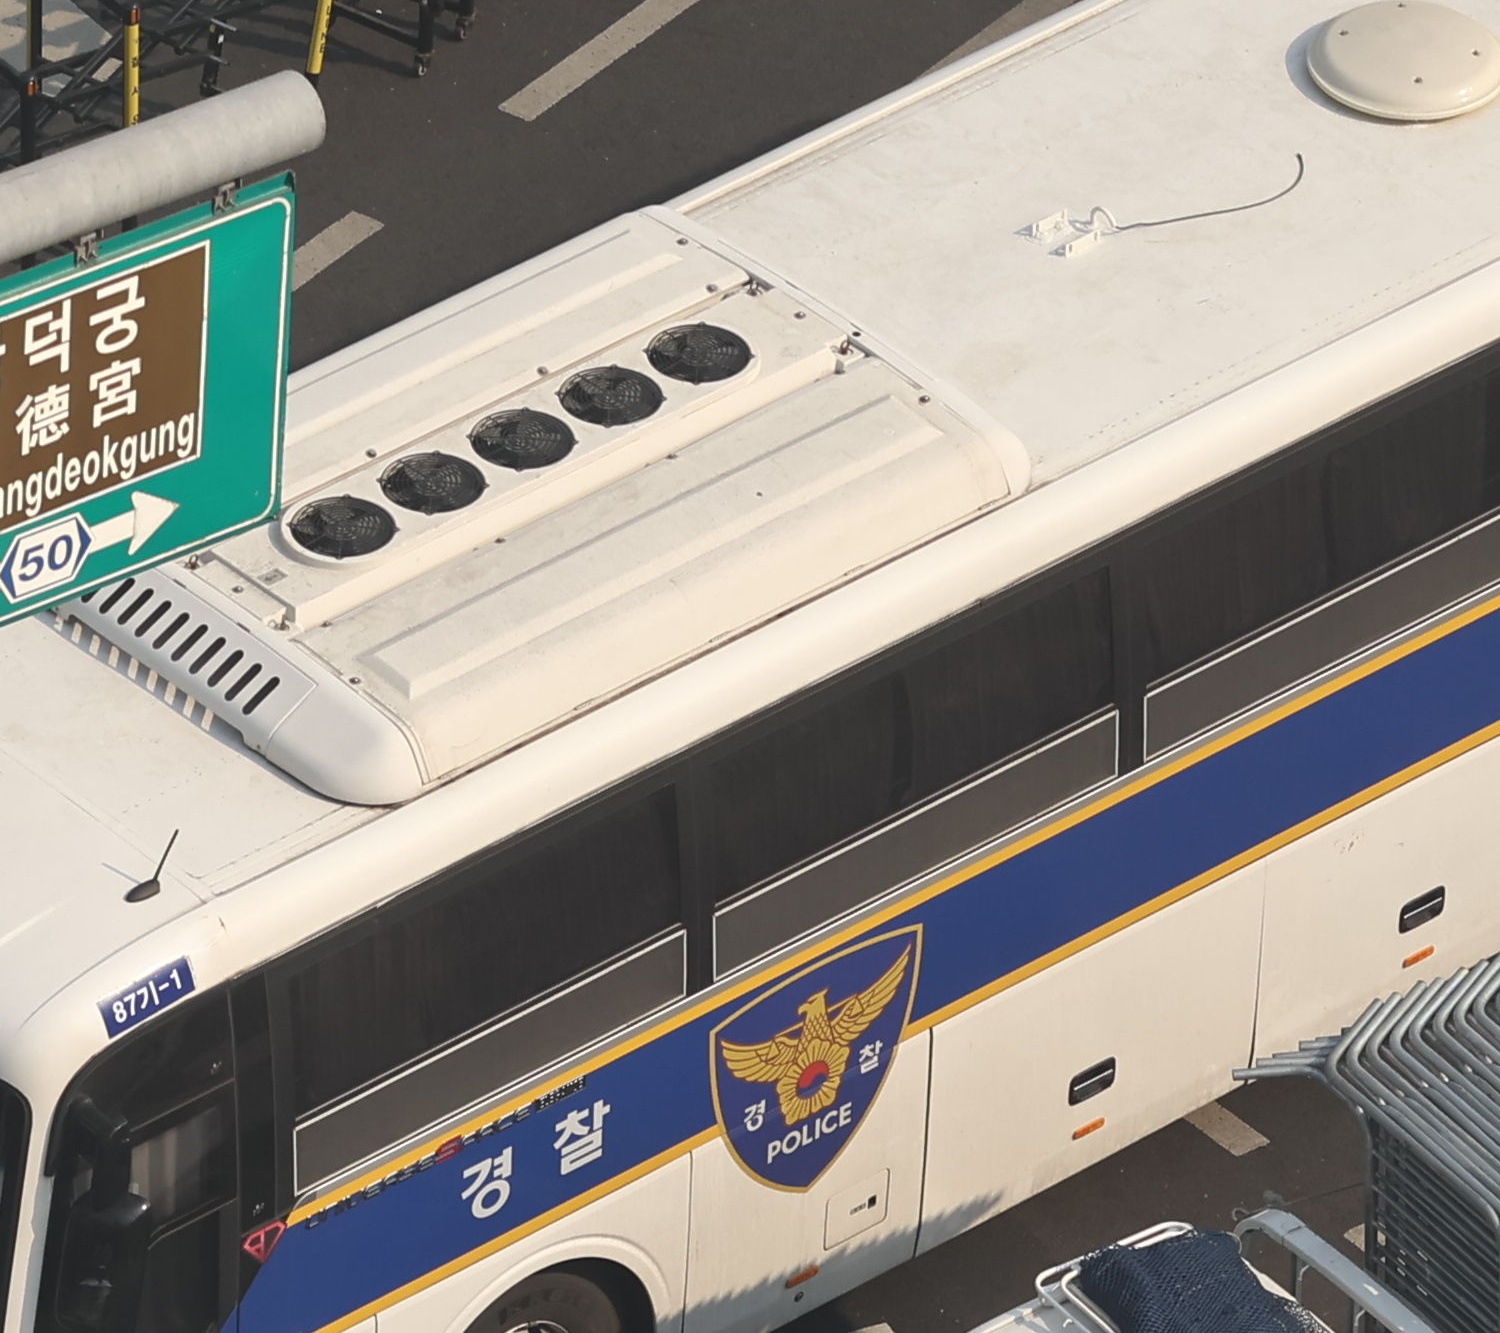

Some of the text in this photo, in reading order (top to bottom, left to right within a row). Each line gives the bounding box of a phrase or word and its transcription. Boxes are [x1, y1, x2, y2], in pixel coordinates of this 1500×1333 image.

[22, 533, 73, 577] 50
[111, 968, 182, 1024] 87기-1
[766, 1101, 854, 1165] POLICE
